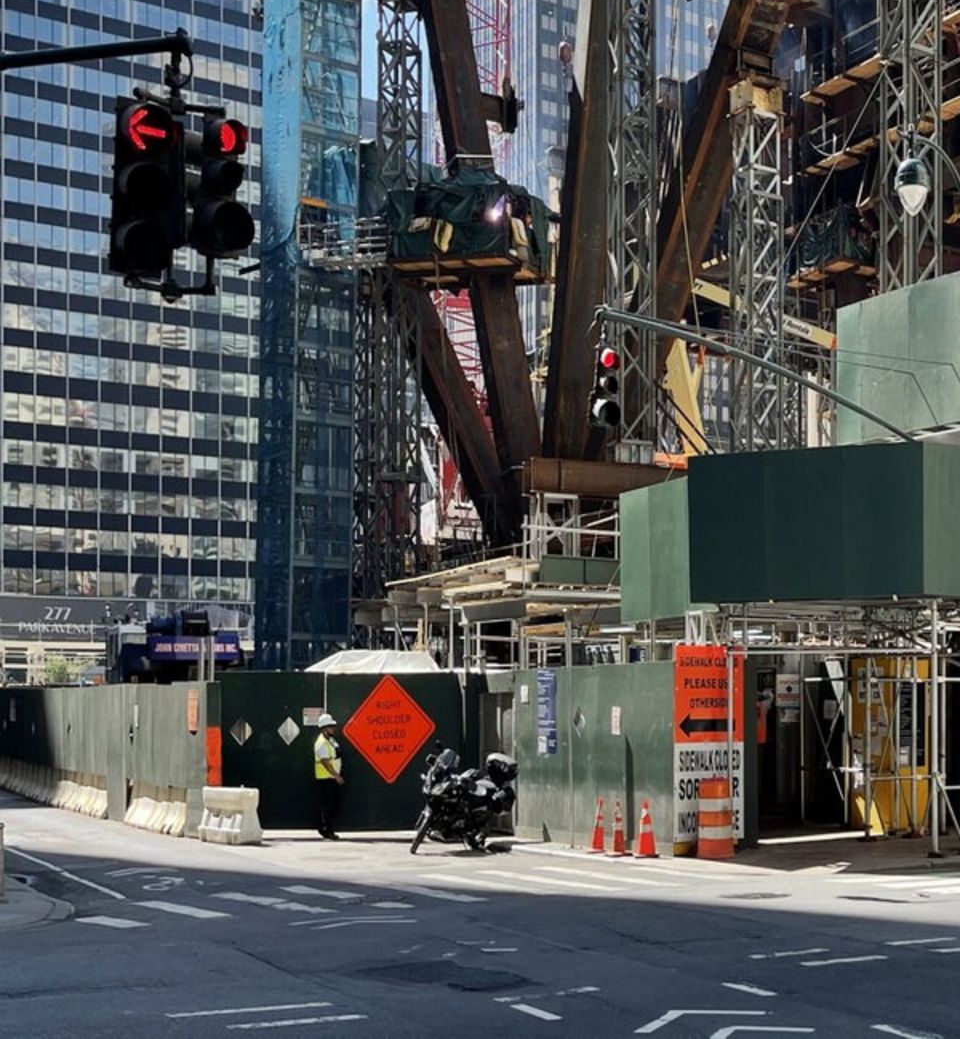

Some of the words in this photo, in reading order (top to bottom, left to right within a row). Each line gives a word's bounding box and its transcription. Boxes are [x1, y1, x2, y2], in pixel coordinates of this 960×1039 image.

[44, 606, 72, 621] 277
[18, 621, 49, 634] PARK
[50, 622, 97, 635] AVENUE
[683, 677, 717, 690] PLEASE
[375, 700, 402, 709] RIGHT
[366, 714, 412, 725] SHOULDER
[372, 729, 406, 740] CLOSED
[375, 744, 404, 754] AHEAD
[679, 750, 713, 772] SIDEWALK
[714, 749, 740, 771] CLOED
